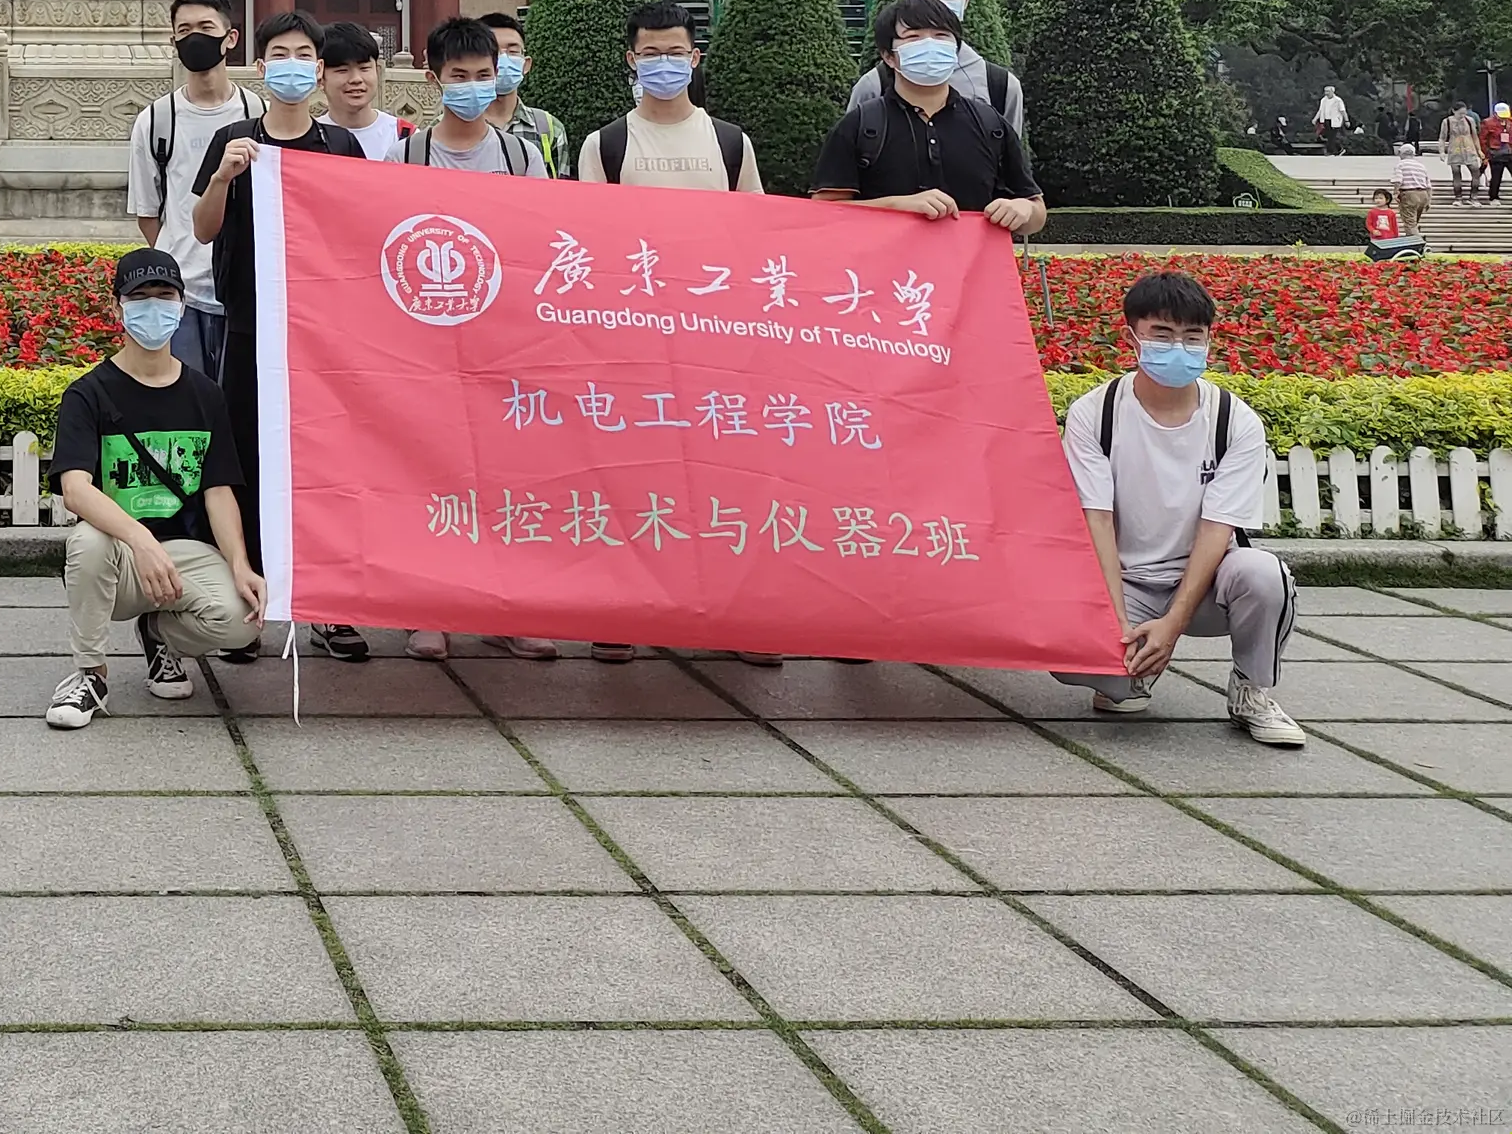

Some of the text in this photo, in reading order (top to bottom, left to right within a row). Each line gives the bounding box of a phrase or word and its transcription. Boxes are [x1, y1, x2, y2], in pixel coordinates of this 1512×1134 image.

[123, 265, 177, 283] MIRACLE
[396, 244, 413, 294] GUANGDONG
[407, 228, 454, 243] UNIVERSITY
[457, 234, 469, 244] OF
[535, 302, 952, 366] Guangdong University of Technology
[502, 378, 883, 451] 机电工程学院
[426, 487, 981, 567] 测控技术与仪器2班
